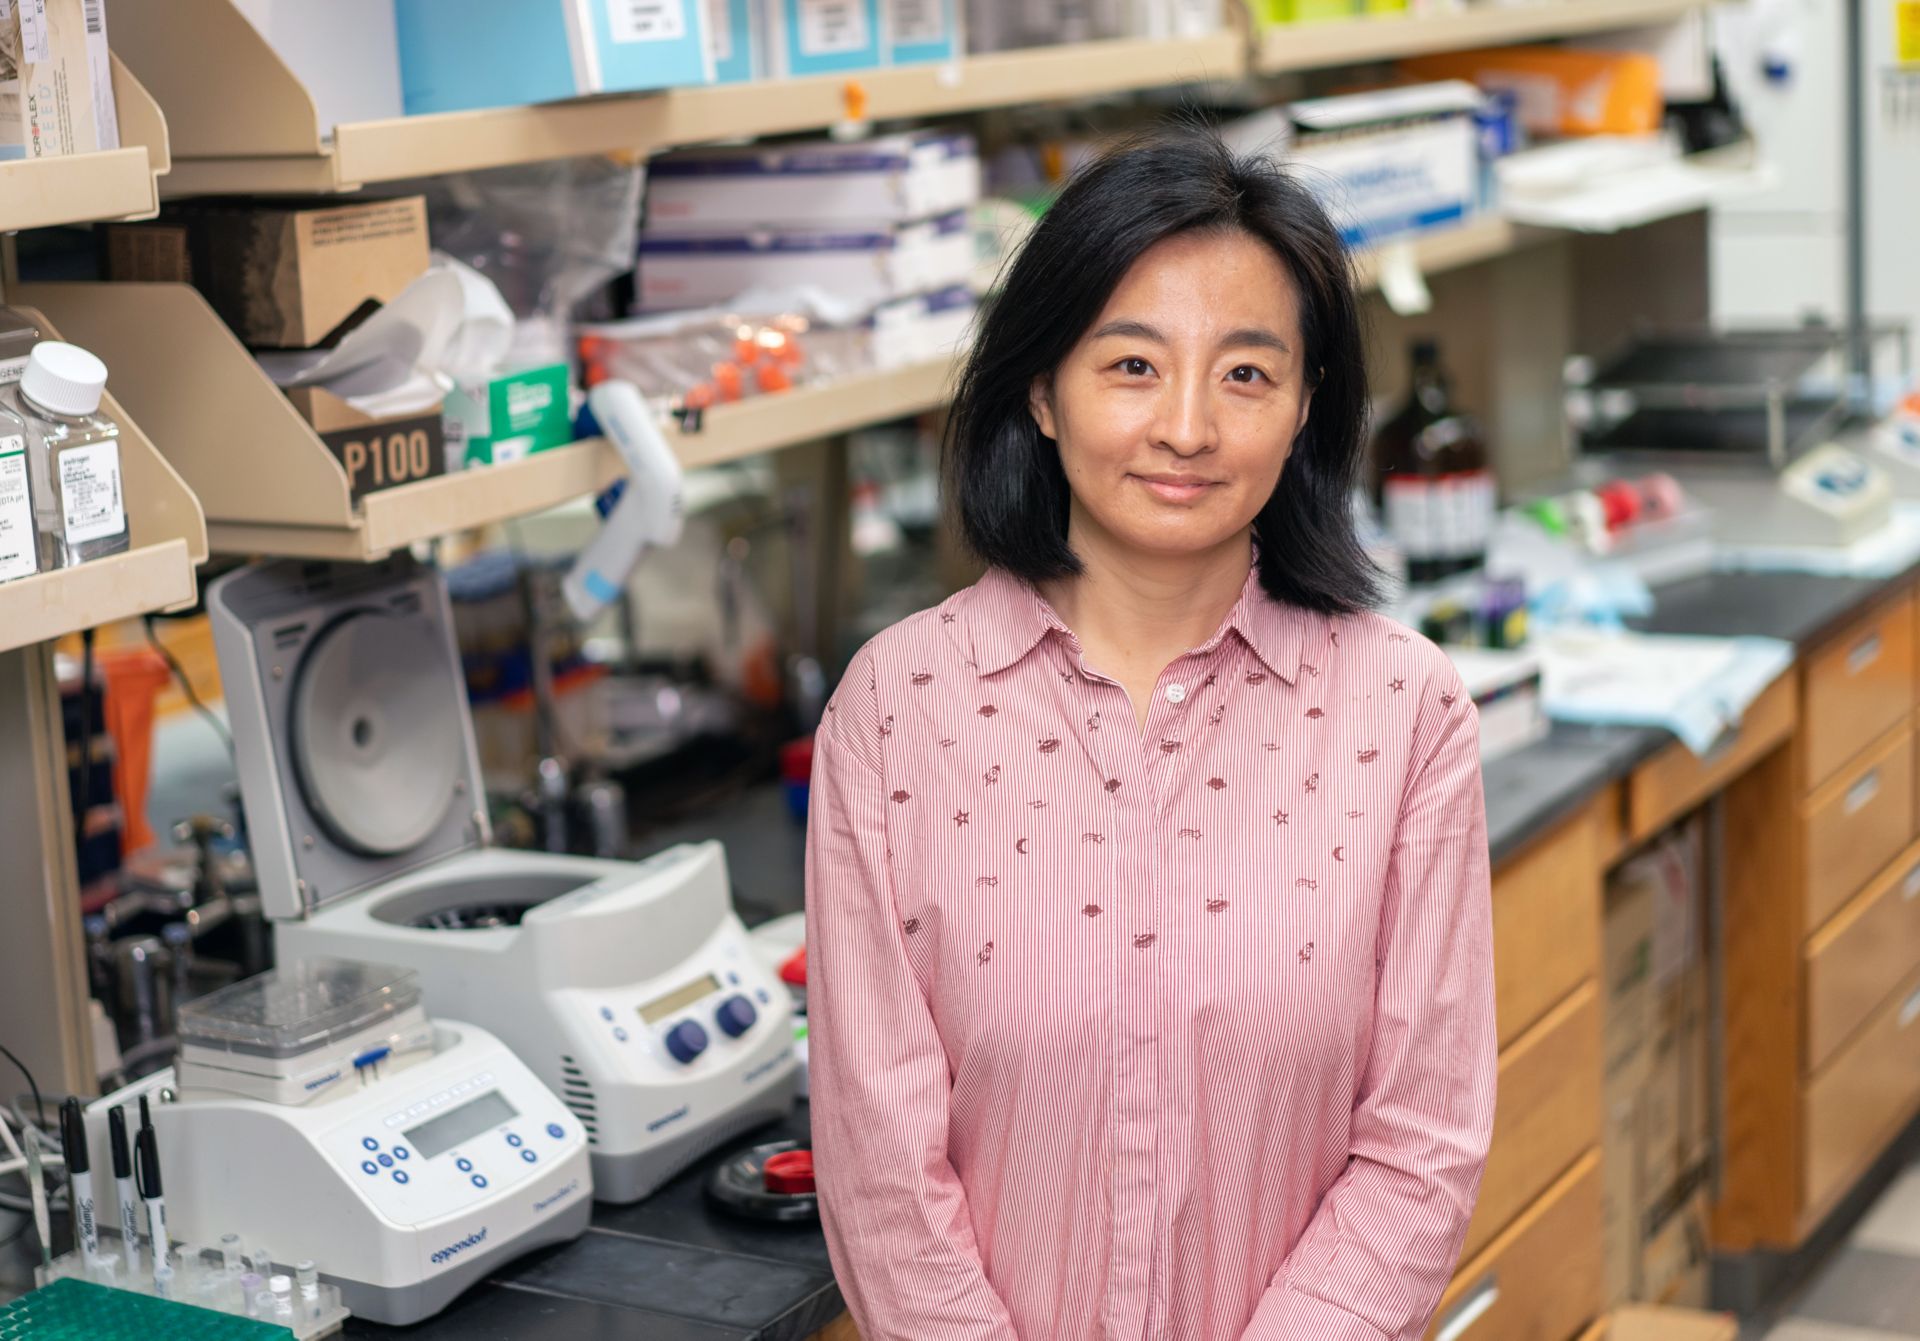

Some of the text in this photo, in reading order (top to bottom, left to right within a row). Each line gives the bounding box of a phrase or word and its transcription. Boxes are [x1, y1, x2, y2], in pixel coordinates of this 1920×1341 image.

[343, 429, 430, 489] P100
[0, 495, 14, 506] DTA
[430, 1226, 489, 1265] eppendorf
